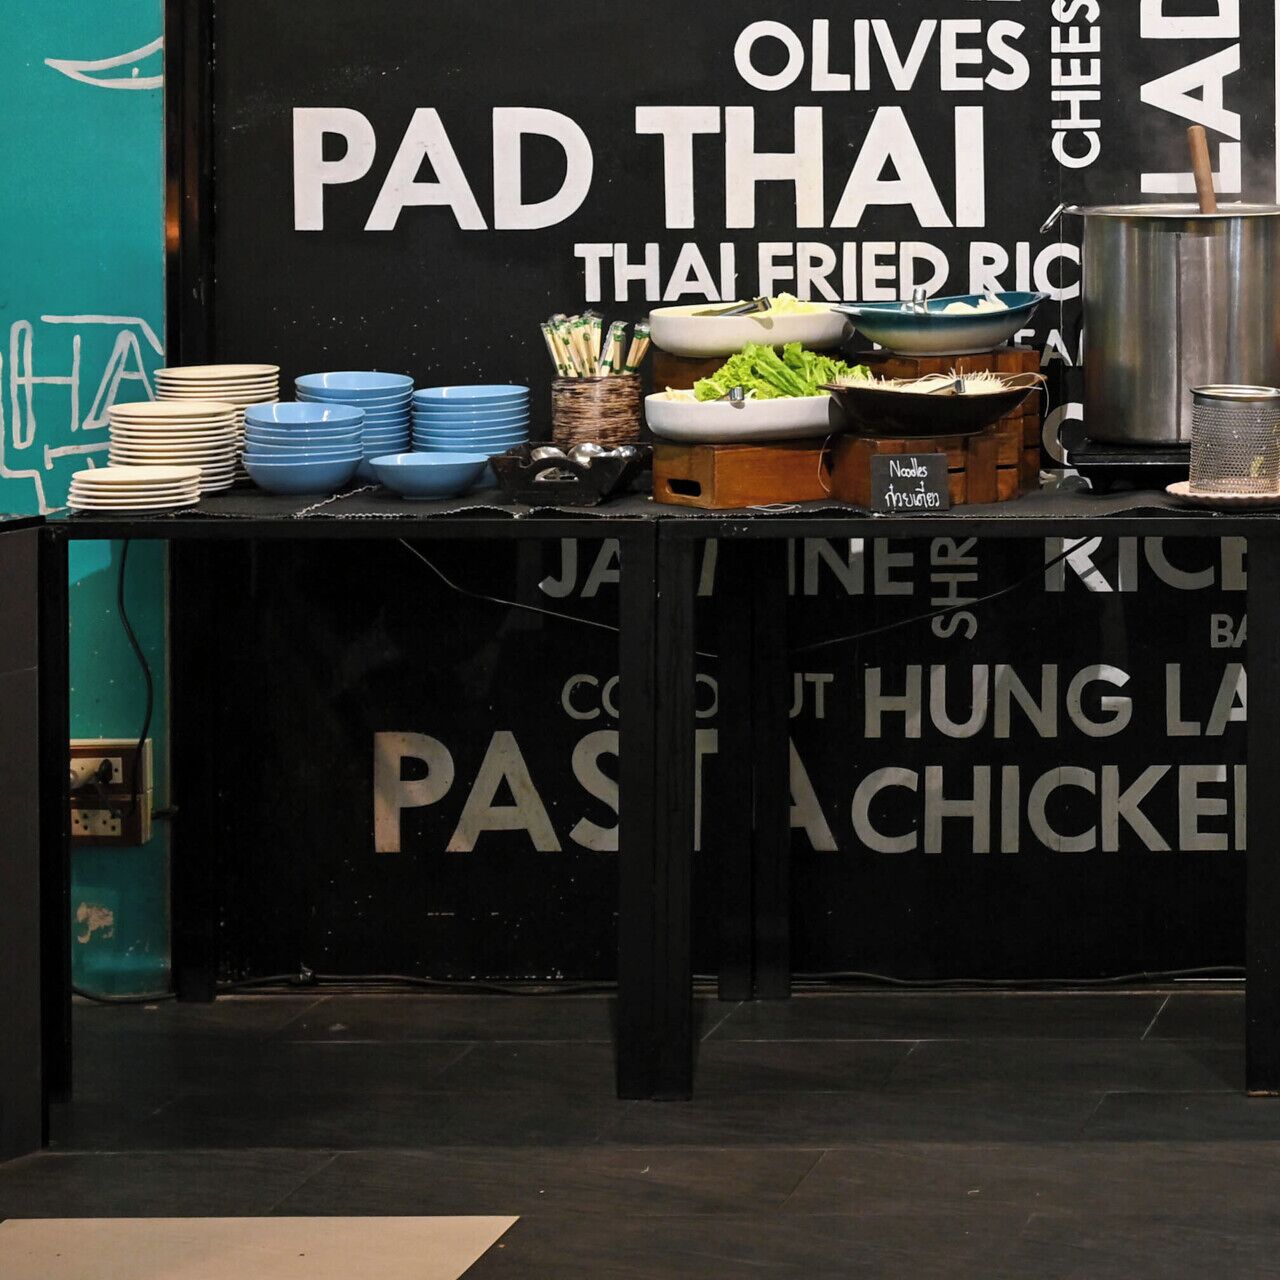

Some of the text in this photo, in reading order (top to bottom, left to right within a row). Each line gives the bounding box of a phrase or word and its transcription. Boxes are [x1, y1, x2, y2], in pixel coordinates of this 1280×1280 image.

[733, 18, 1030, 92] OLIVES
[292, 106, 986, 231] PAD THAI
[573, 241, 1080, 303] THAI FRIED RIC
[889, 457, 928, 478] Noodles
[864, 663, 1133, 739] HUNG
